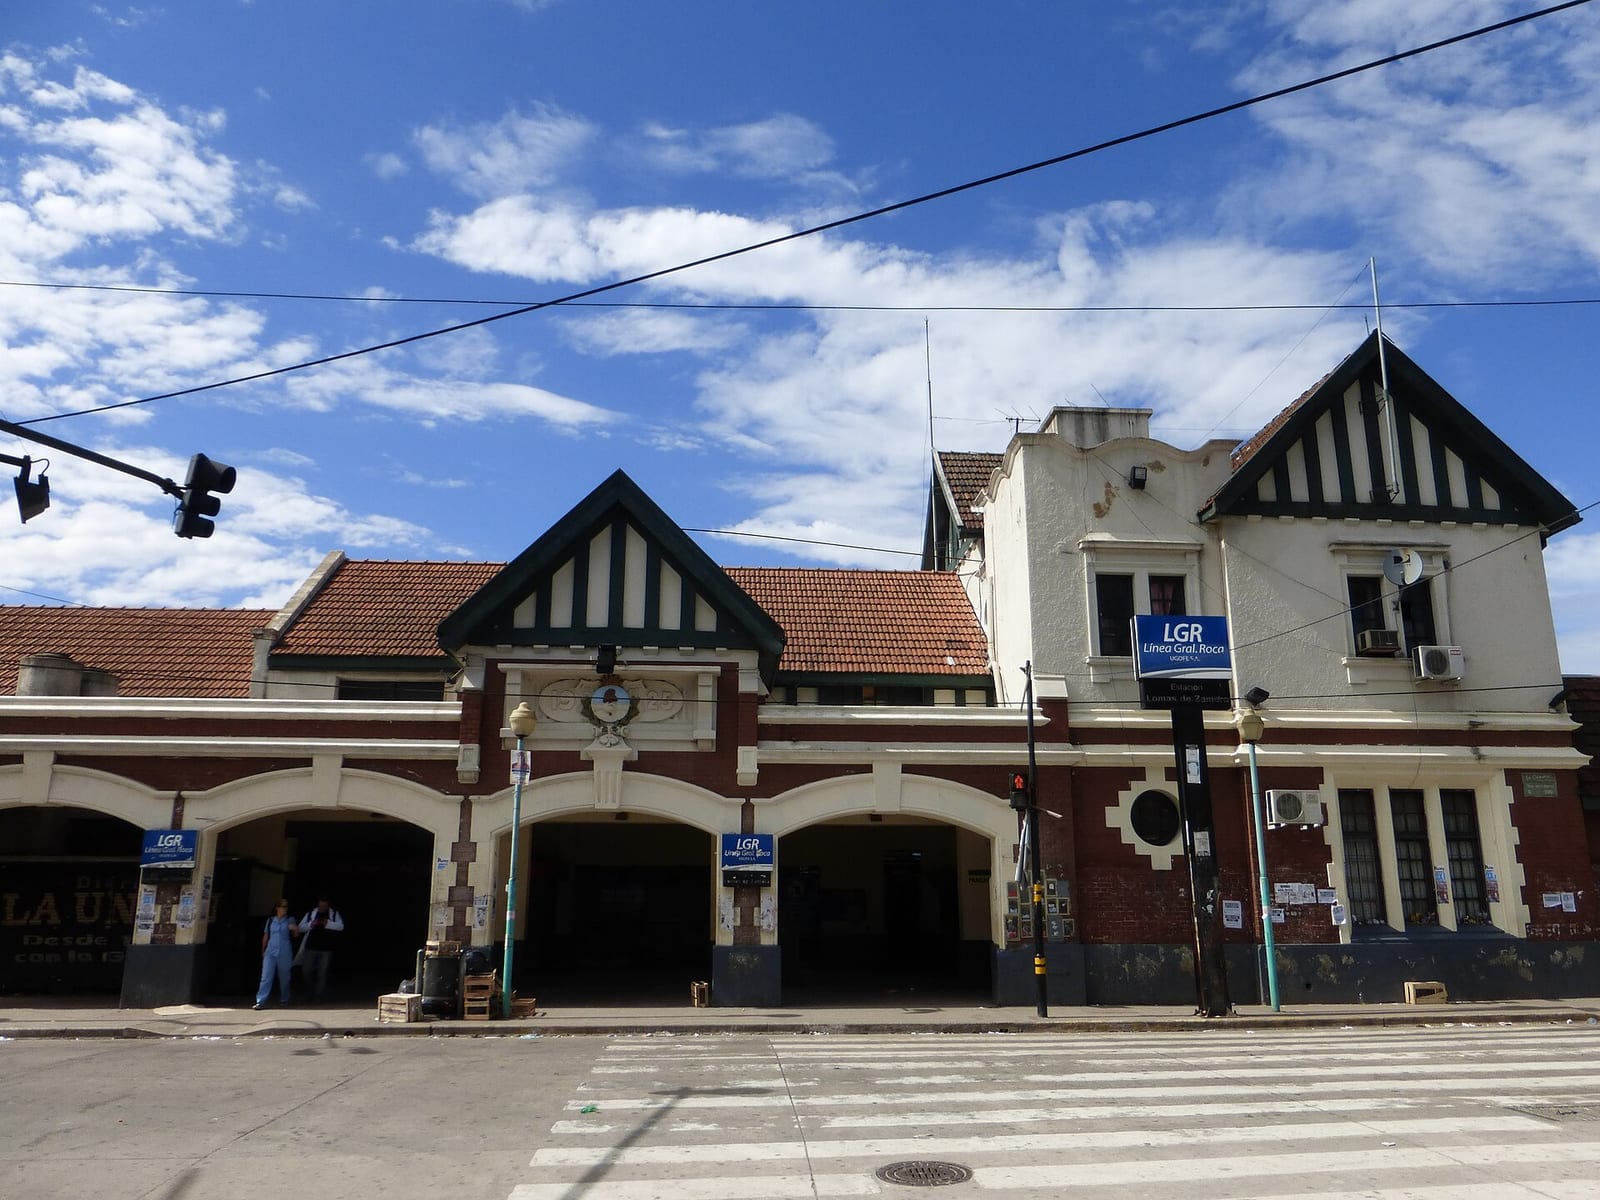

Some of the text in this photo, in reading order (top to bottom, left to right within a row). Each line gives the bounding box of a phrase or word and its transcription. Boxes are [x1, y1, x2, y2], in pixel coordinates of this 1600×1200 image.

[1163, 623, 1203, 643] LGR
[1143, 642, 1225, 654] Línea Gral. Roca
[1180, 694, 1191, 703] de
[157, 834, 183, 847] LGR
[736, 838, 760, 850] LGR
[0, 891, 63, 927] LA
[73, 891, 138, 927] UN
[23, 934, 109, 946] Desde
[14, 952, 62, 963] con
[67, 950, 93, 963] la
